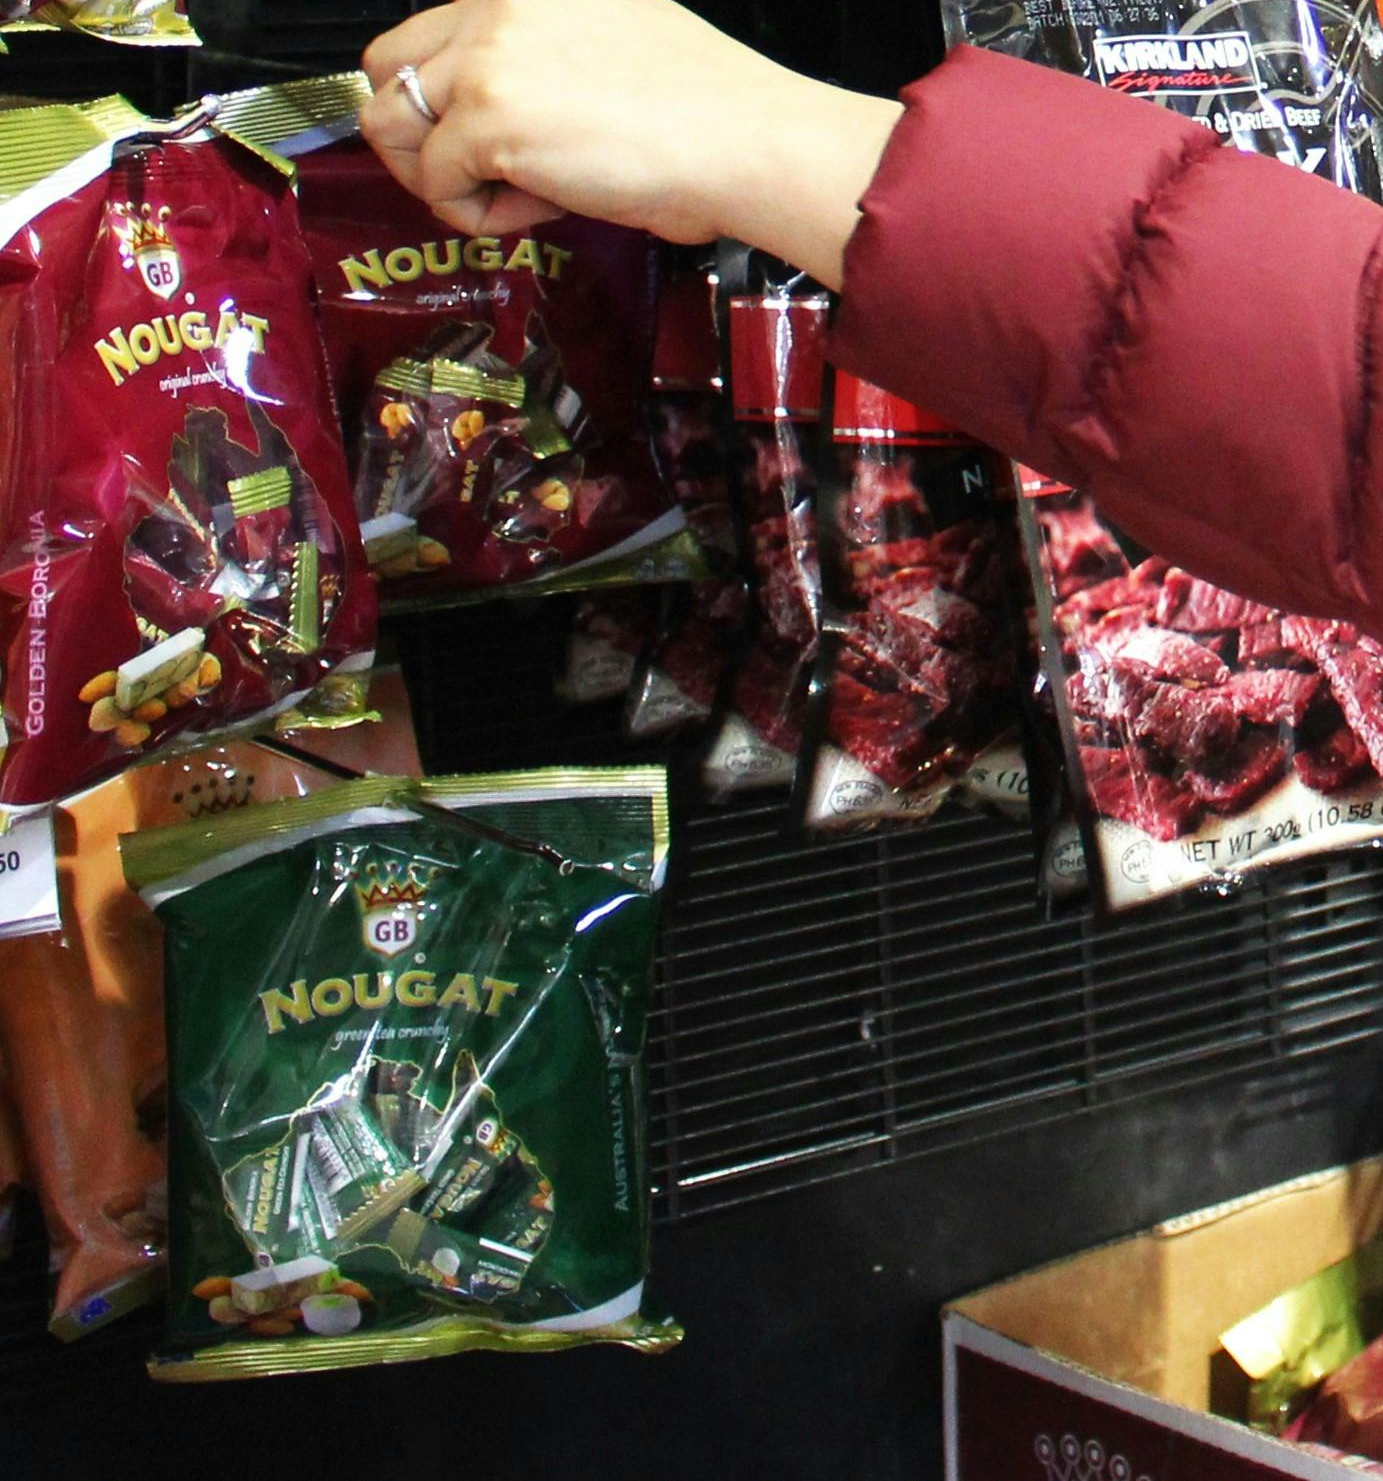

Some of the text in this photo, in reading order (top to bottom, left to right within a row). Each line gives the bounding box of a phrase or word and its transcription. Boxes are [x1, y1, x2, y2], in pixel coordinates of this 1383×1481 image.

[1101, 36, 1251, 74] KIRKLAND
[1106, 71, 1252, 94] Signature
[1284, 105, 1322, 128] BEEF
[146, 261, 174, 286] GB
[338, 237, 573, 294] NOUGAT
[94, 311, 270, 386] NOUGAT
[25, 627, 48, 739] GOLDEN
[1228, 830, 1258, 855] WT
[374, 920, 409, 943] GB
[259, 970, 520, 1035] NOUGAT
[398, 1018, 450, 1045] crunchy
[608, 1073, 630, 1212] AUSTRALIA'S
